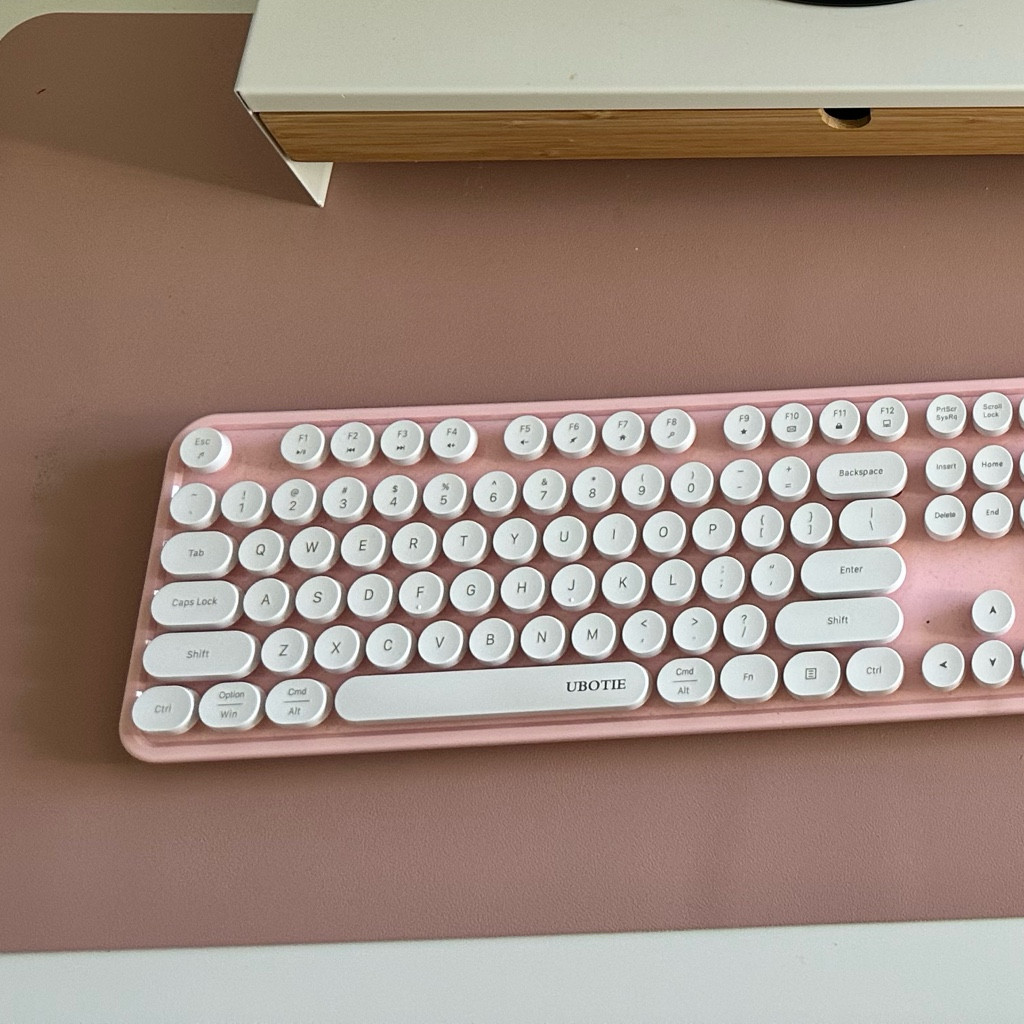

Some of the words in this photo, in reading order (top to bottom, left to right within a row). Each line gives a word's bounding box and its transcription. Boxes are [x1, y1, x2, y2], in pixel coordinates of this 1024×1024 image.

[880, 405, 895, 415] F12
[935, 405, 958, 413] PrtScr
[982, 402, 1003, 411] Scroll
[738, 413, 751, 423] F9
[784, 411, 800, 421] F10
[832, 408, 847, 418] F11
[568, 422, 580, 431] F6
[617, 419, 629, 429] F7
[666, 417, 678, 427] F8
[397, 429, 409, 439] F3
[446, 427, 458, 436] F4
[519, 424, 532, 434] F5
[297, 433, 309, 442] F1
[347, 431, 359, 441] F2
[194, 437, 211, 447] Esc
[936, 462, 957, 470] Insert
[838, 468, 884, 477] Backspace
[934, 511, 957, 519] Delete
[985, 508, 1000, 516] End
[658, 525, 669, 539] O
[708, 523, 718, 535] P
[510, 532, 520, 545] Y
[559, 530, 570, 543] U
[611, 528, 616, 541] I
[358, 539, 368, 552] E
[408, 537, 419, 550] R
[460, 534, 469, 547] T
[255, 543, 266, 557] Q
[305, 541, 320, 553] W
[188, 548, 205, 558] Tab
[839, 565, 864, 575] Enter
[363, 588, 375, 602] D
[415, 585, 425, 599] F
[465, 583, 476, 597] G
[260, 593, 271, 606] A
[312, 590, 323, 604] S
[171, 598, 195, 609] Caps
[196, 596, 218, 607] Lock
[827, 615, 849, 626] Shift
[186, 649, 210, 660] Shift
[675, 667, 695, 677] Cmd
[865, 665, 883, 675] Ctrl
[742, 672, 754, 681] Fn
[566, 678, 626, 693] UBOTIE
[677, 686, 690, 695] Alt
[218, 690, 246, 701] Option
[287, 687, 308, 697] Cmd
[153, 703, 173, 715] Ctrl
[287, 706, 302, 716] Alt
[220, 710, 238, 719] Win
